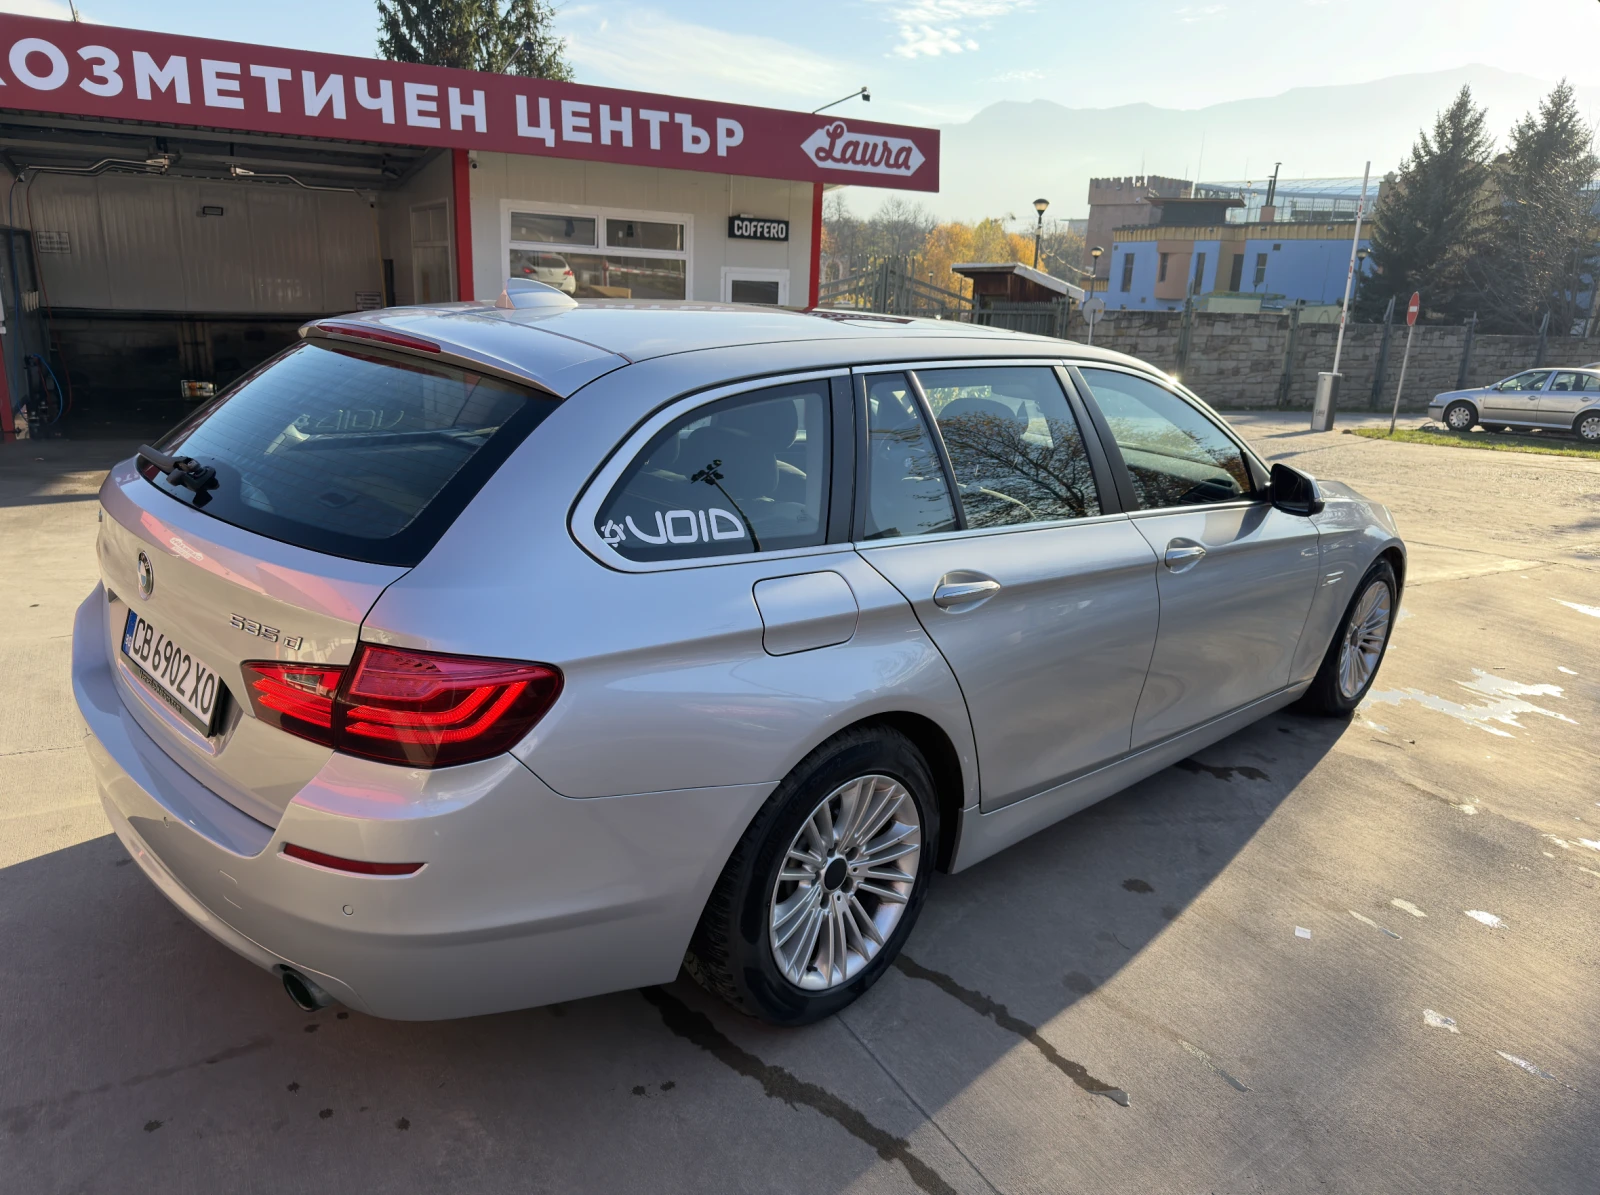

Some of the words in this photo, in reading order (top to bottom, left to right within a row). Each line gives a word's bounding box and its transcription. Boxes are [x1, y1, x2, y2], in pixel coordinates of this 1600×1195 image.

[0, 37, 488, 134] ОЗМЕТИЧЕН
[515, 94, 744, 158] ЦЕНТЪР
[814, 123, 913, 171] Laura
[733, 219, 787, 239] COFFERO
[625, 507, 746, 545] VOID
[132, 617, 154, 663] CB
[152, 633, 192, 698] 6902
